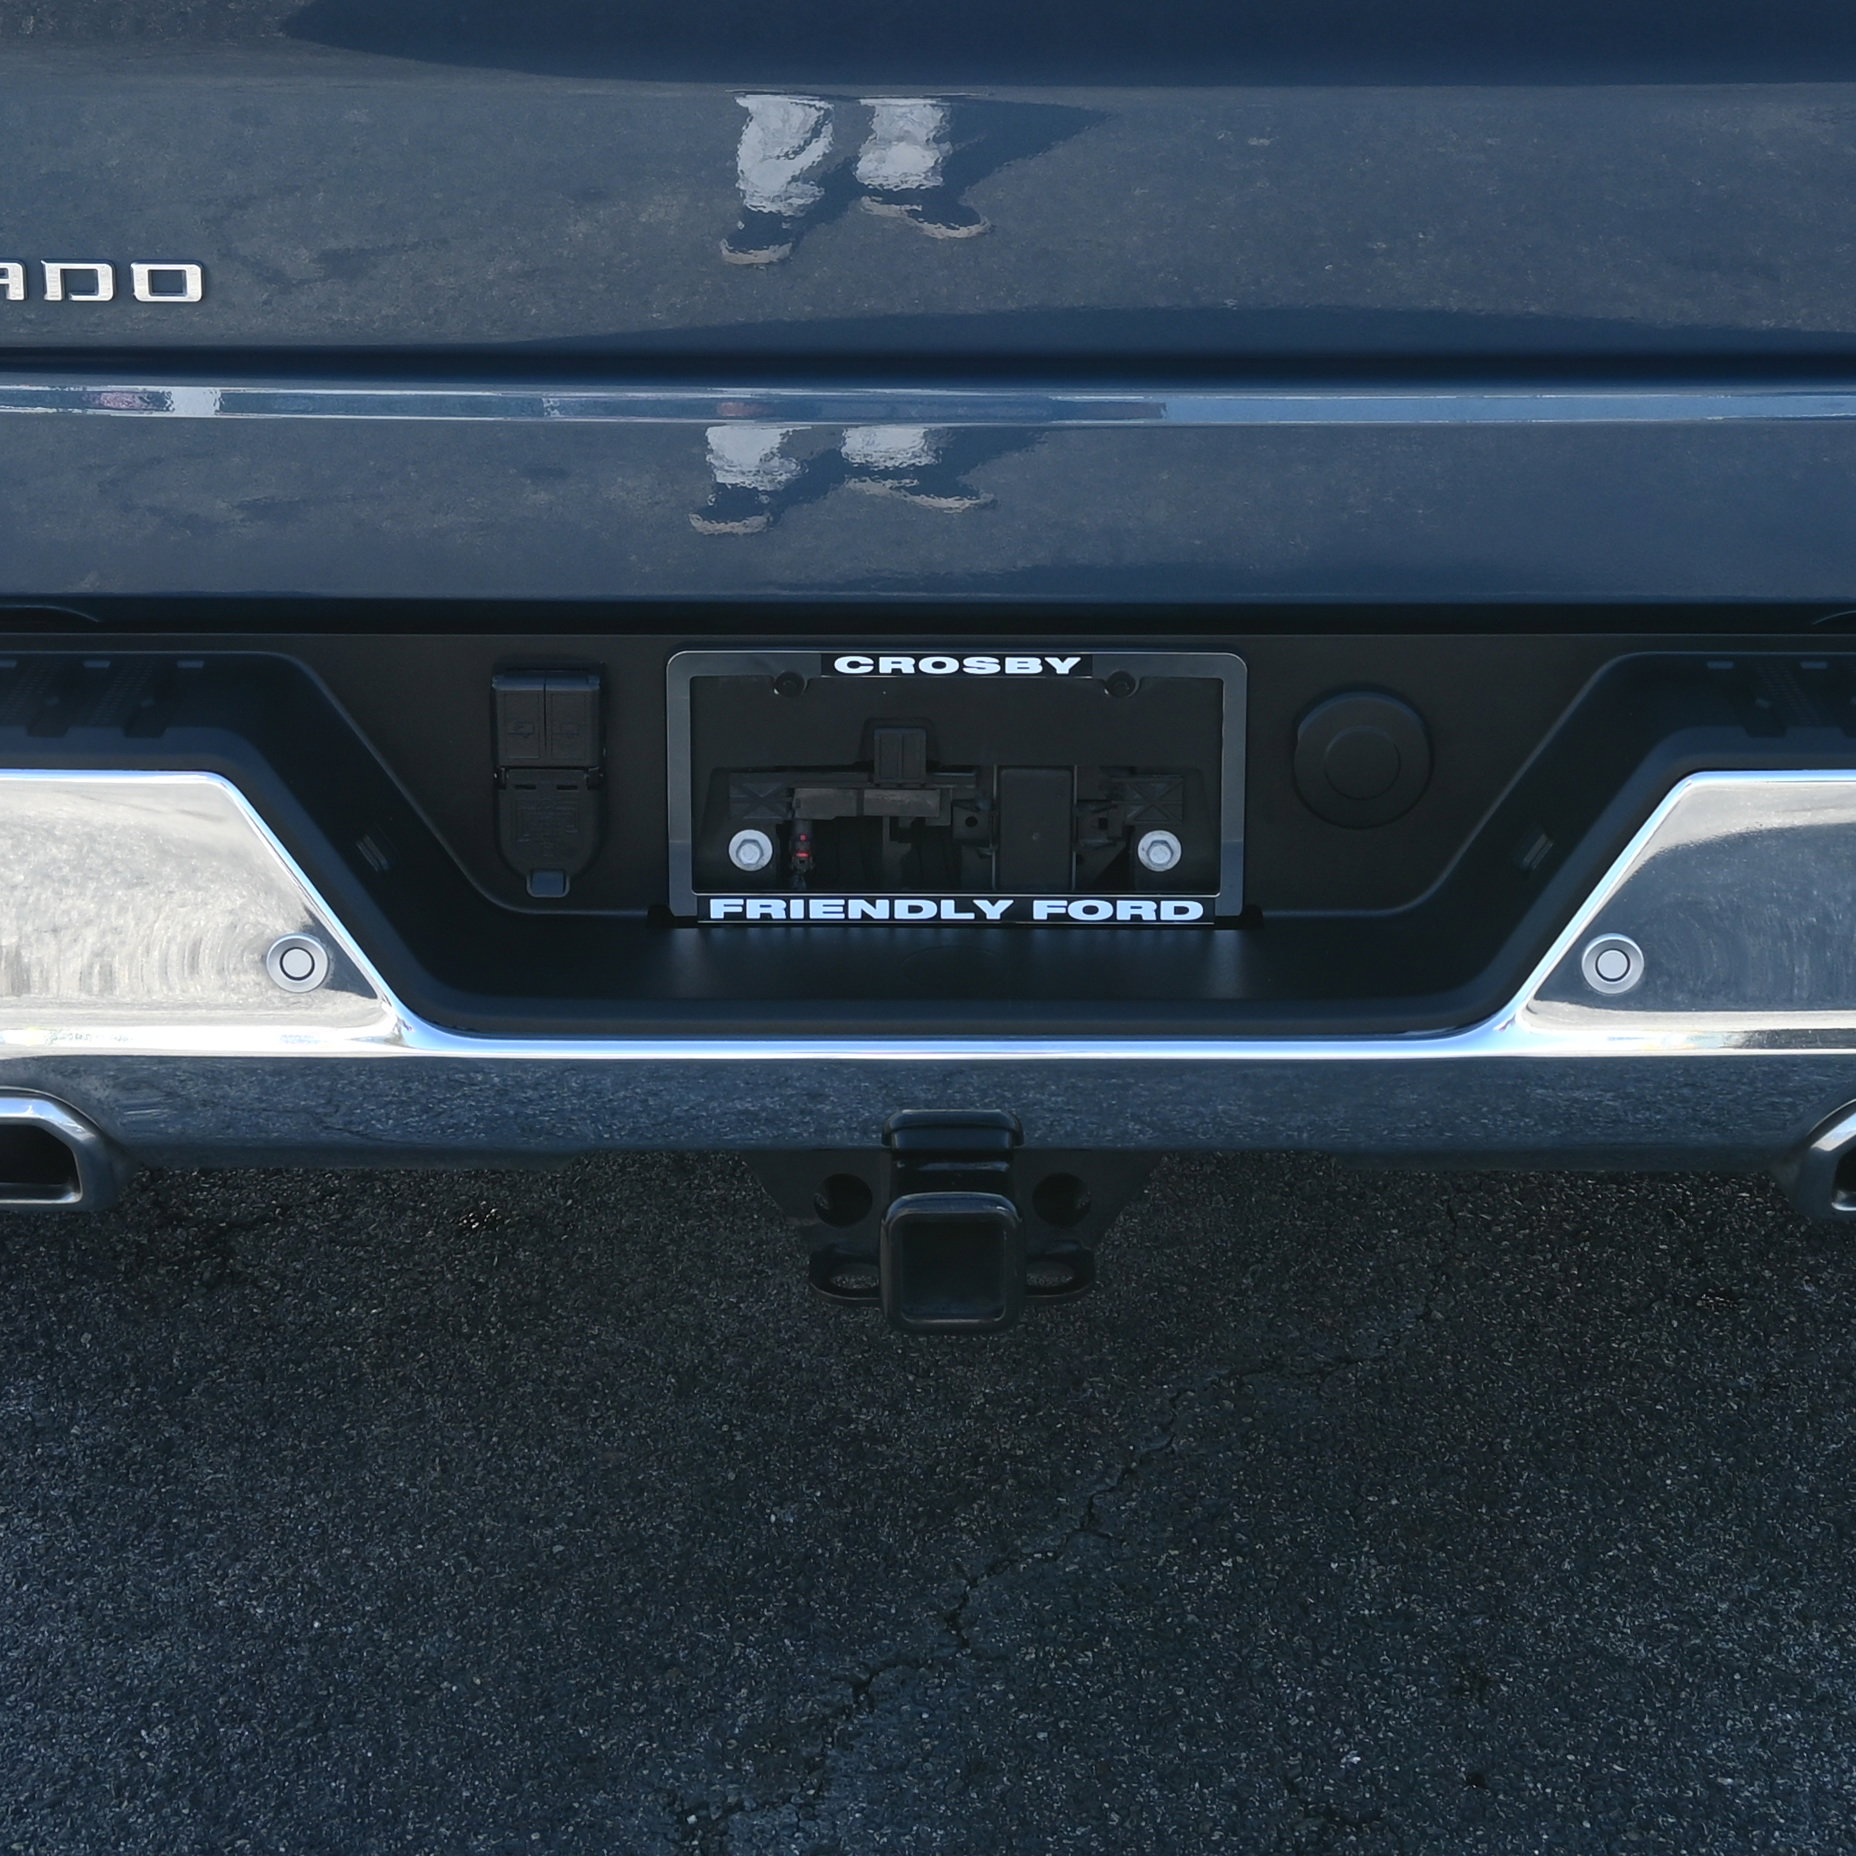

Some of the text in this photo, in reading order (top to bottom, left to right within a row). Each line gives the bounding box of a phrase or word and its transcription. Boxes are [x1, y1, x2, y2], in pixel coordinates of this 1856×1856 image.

[833, 655, 1082, 676] CROSBY
[709, 898, 1205, 922] FRIENDLY FORD
